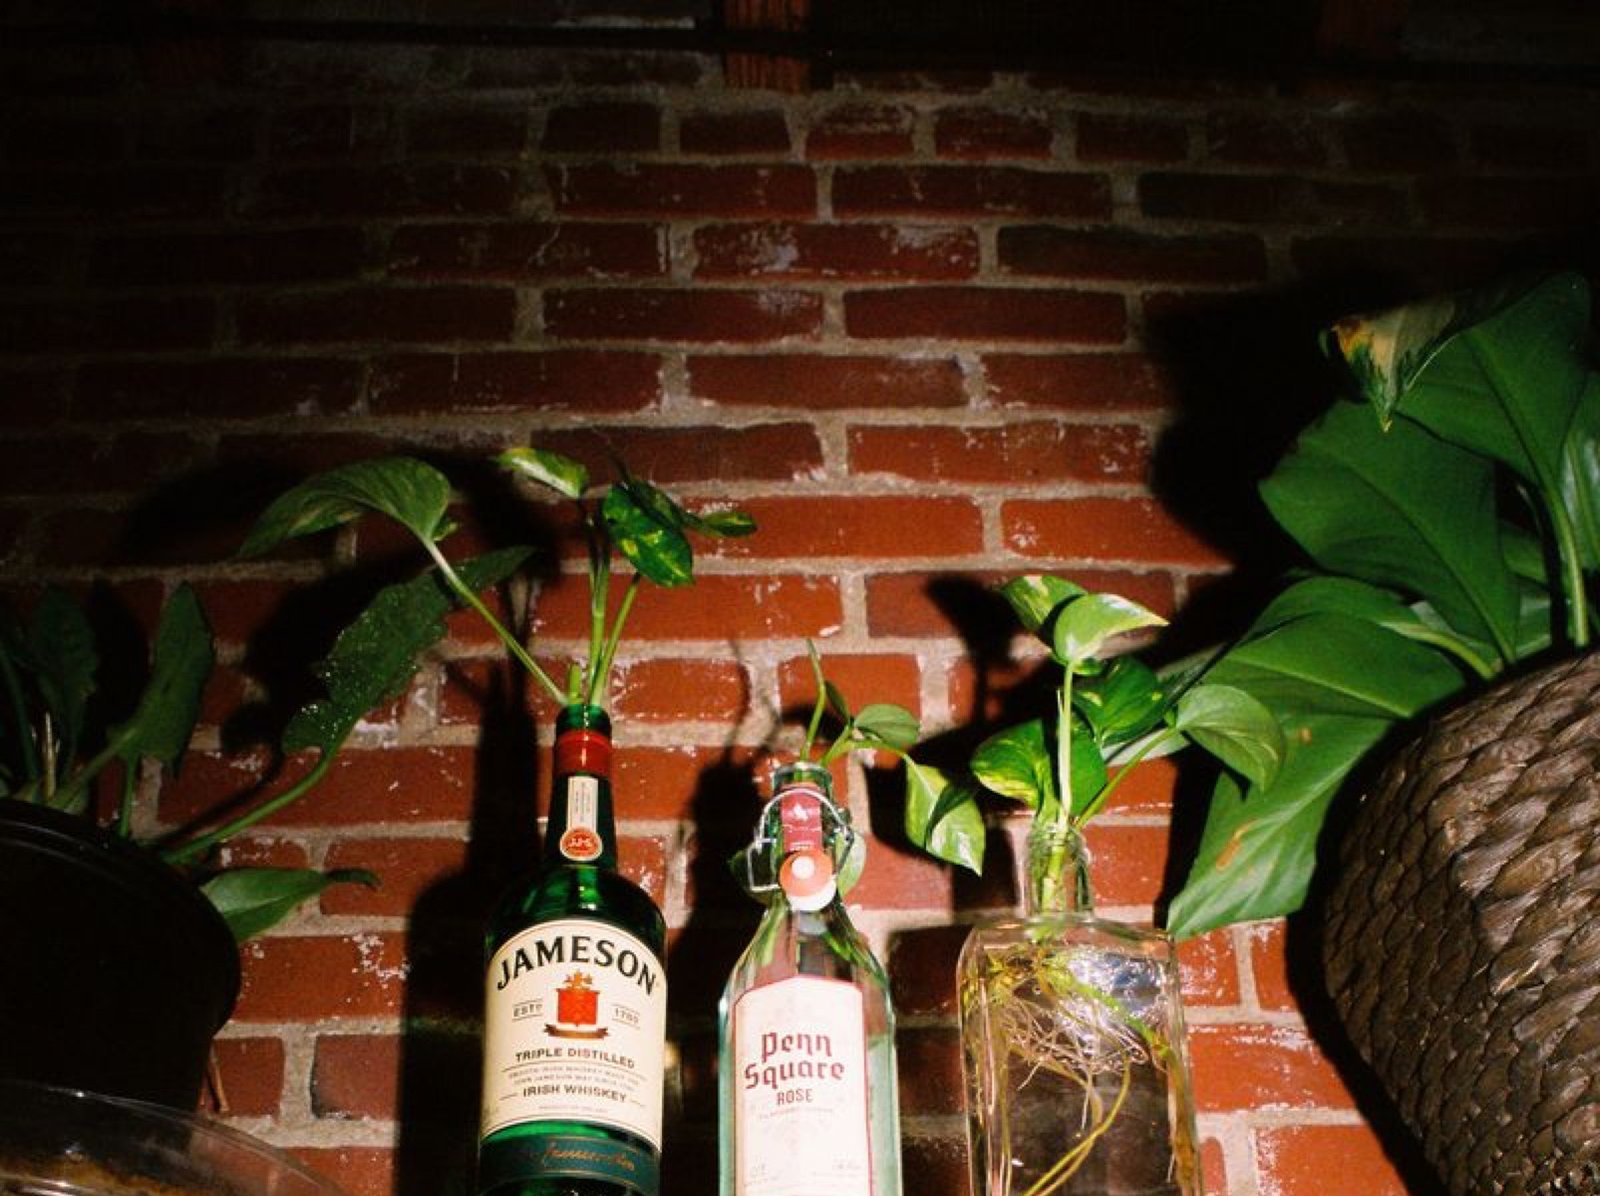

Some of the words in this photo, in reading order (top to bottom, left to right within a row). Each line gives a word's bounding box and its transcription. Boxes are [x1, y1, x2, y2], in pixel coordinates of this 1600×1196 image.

[497, 936, 656, 996] JAMESON
[515, 1048, 563, 1064] TRIPLE
[567, 1048, 635, 1069] DISTILLED
[761, 1032, 832, 1064] Penn
[744, 1060, 845, 1090] Square
[523, 1084, 561, 1098] IRISH
[564, 1084, 627, 1103] WHISKEY
